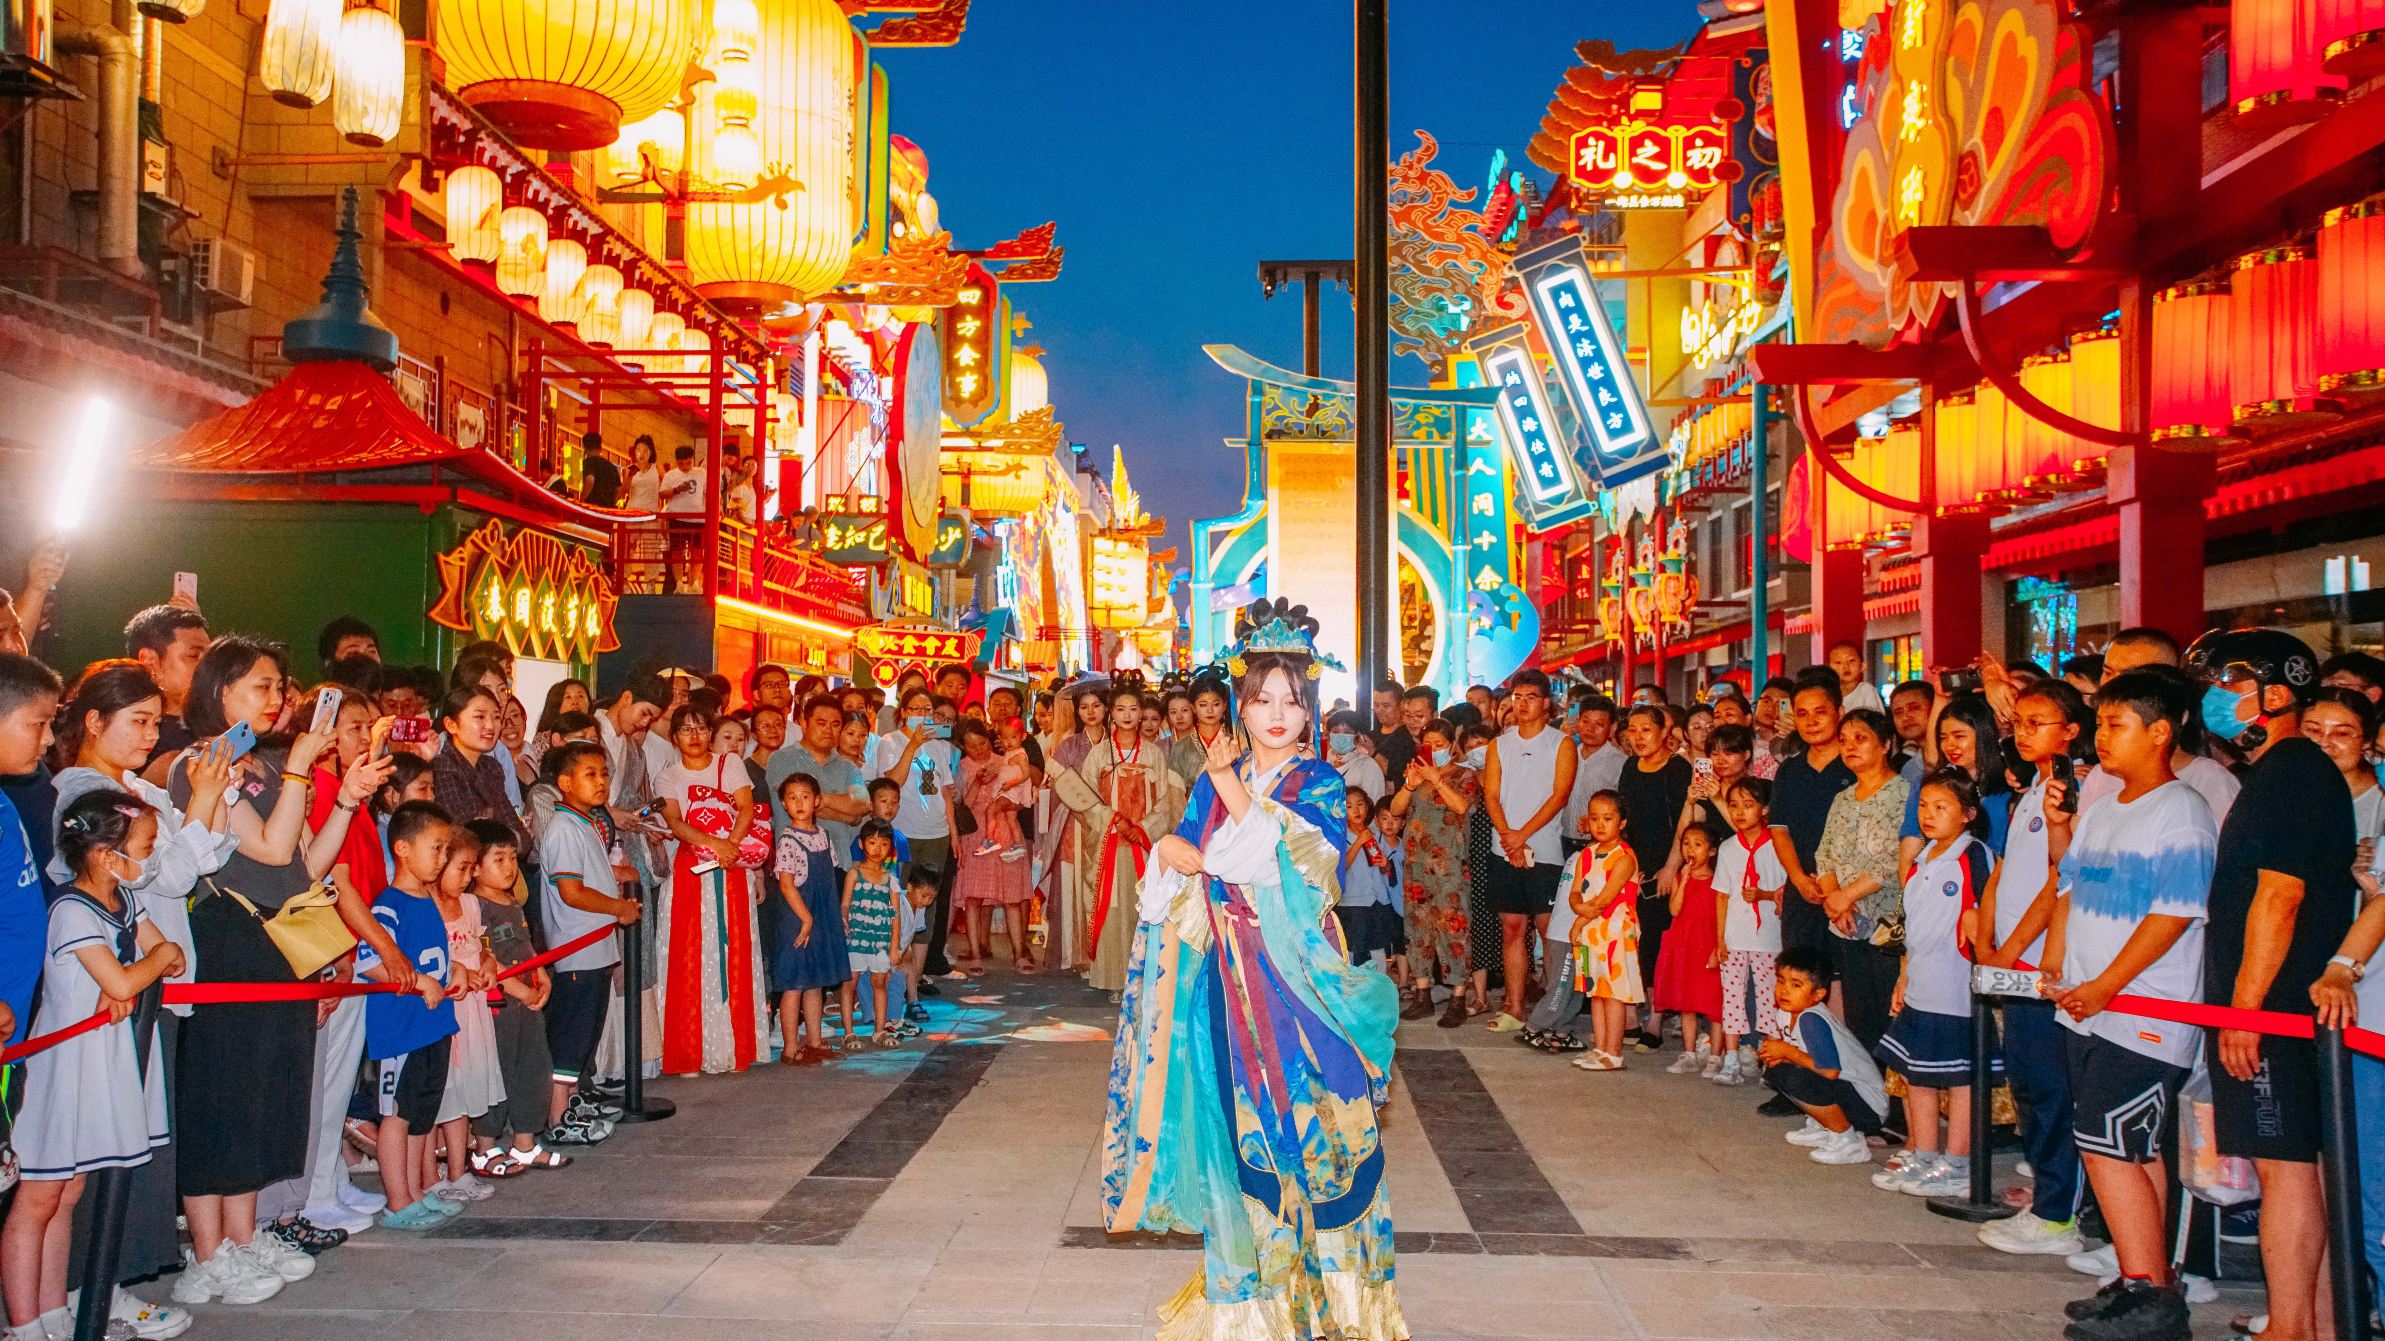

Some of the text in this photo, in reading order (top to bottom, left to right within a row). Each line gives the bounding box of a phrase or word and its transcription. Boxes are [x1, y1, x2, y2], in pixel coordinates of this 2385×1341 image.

[1578, 136, 1723, 171] 礼之初
[953, 289, 982, 399] 四方食事
